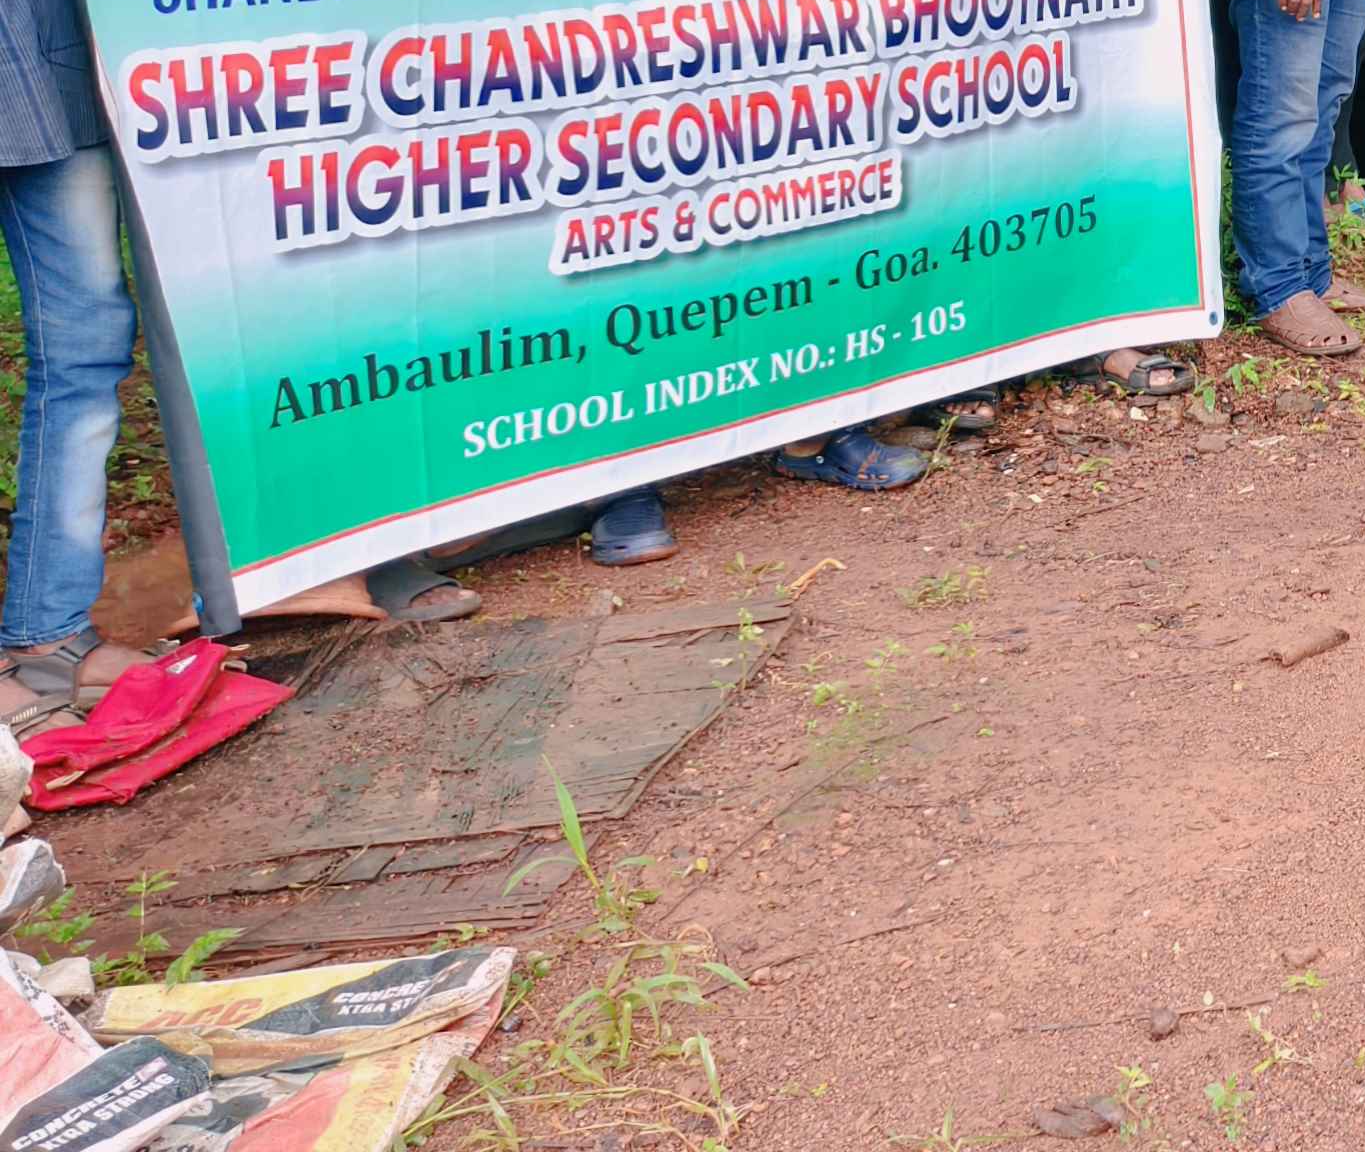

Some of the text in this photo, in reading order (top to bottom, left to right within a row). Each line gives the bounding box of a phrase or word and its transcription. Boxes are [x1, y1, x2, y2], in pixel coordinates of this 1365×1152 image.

[128, 41, 353, 151] SHREE
[267, 40, 1070, 241] HIGHER SECONDARY SCHOOL
[561, 159, 894, 264] ARTS & COMMERCE
[270, 326, 587, 430] Ambaulim,
[606, 274, 813, 356] Quepem
[855, 249, 939, 290] Goa.
[951, 194, 1098, 264] 403705
[463, 390, 634, 458] SCHOOL
[645, 357, 759, 416] INDEX
[769, 343, 836, 381] NO.:
[845, 323, 886, 360] HS
[910, 301, 967, 342] 105
[333, 979, 432, 1004] CONCRE
[12, 1075, 142, 1151] CONCRETE
[93, 1073, 175, 1122] STRONG
